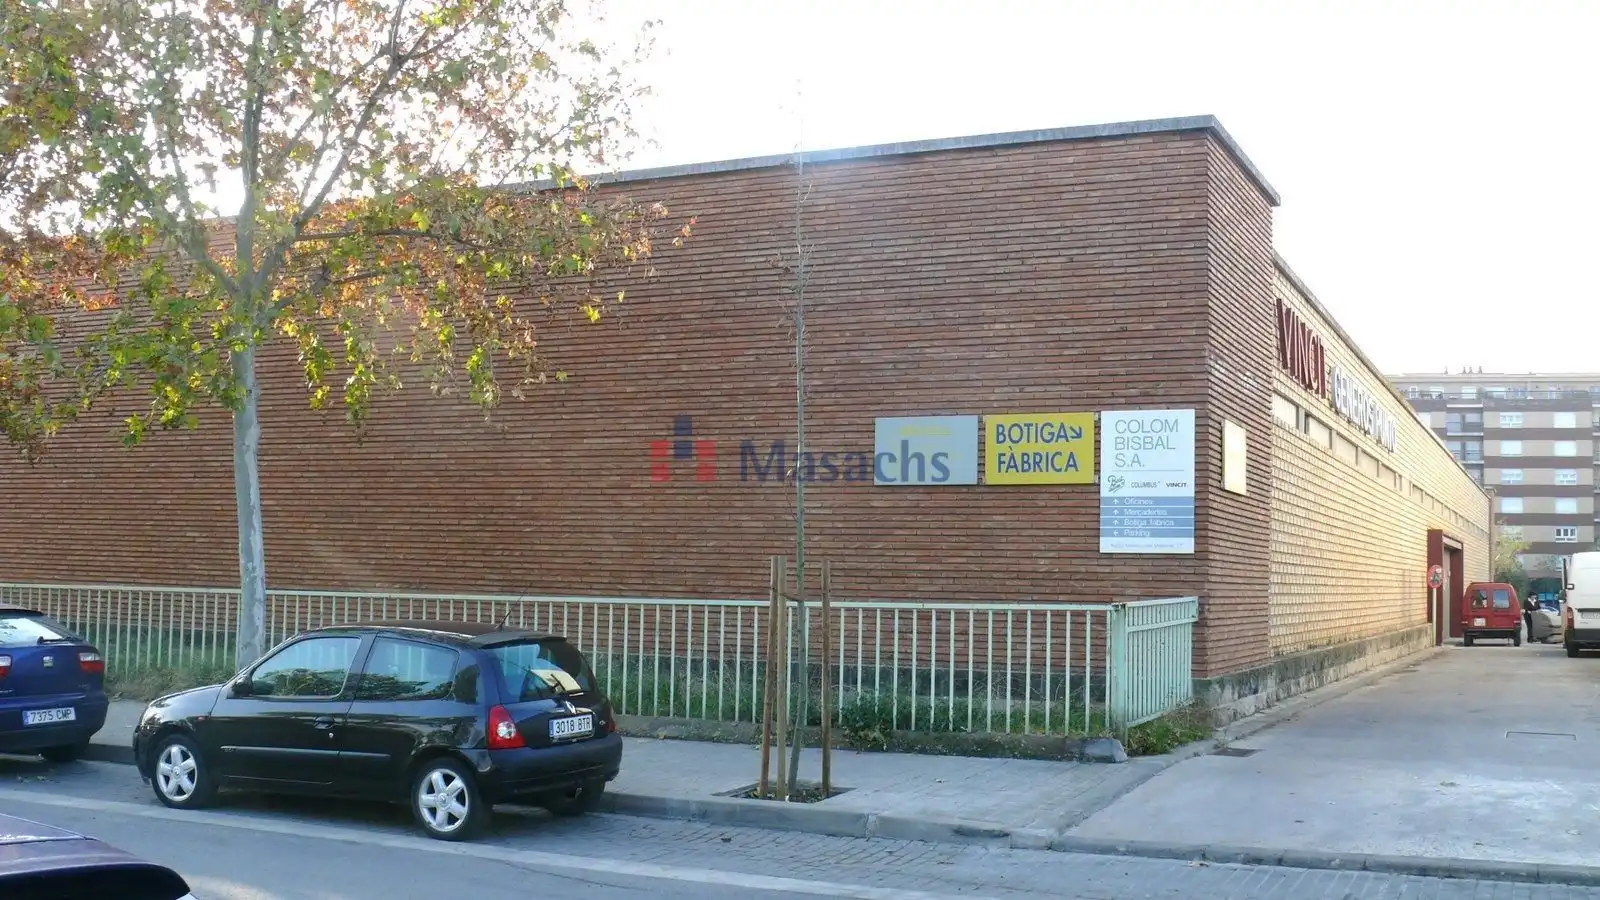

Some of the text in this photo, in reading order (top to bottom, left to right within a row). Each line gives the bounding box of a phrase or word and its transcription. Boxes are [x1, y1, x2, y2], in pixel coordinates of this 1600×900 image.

[995, 422, 1070, 445] BOTIGA
[1114, 418, 1179, 434] COLOM
[1114, 435, 1177, 451] BISBAL
[997, 446, 1079, 474] FÀBRICA
[1114, 452, 1146, 468] S.A.
[1123, 529, 1150, 538] Parking
[30, 711, 54, 722] 7375
[555, 719, 575, 734] 3018
[577, 716, 591, 731] BTR
